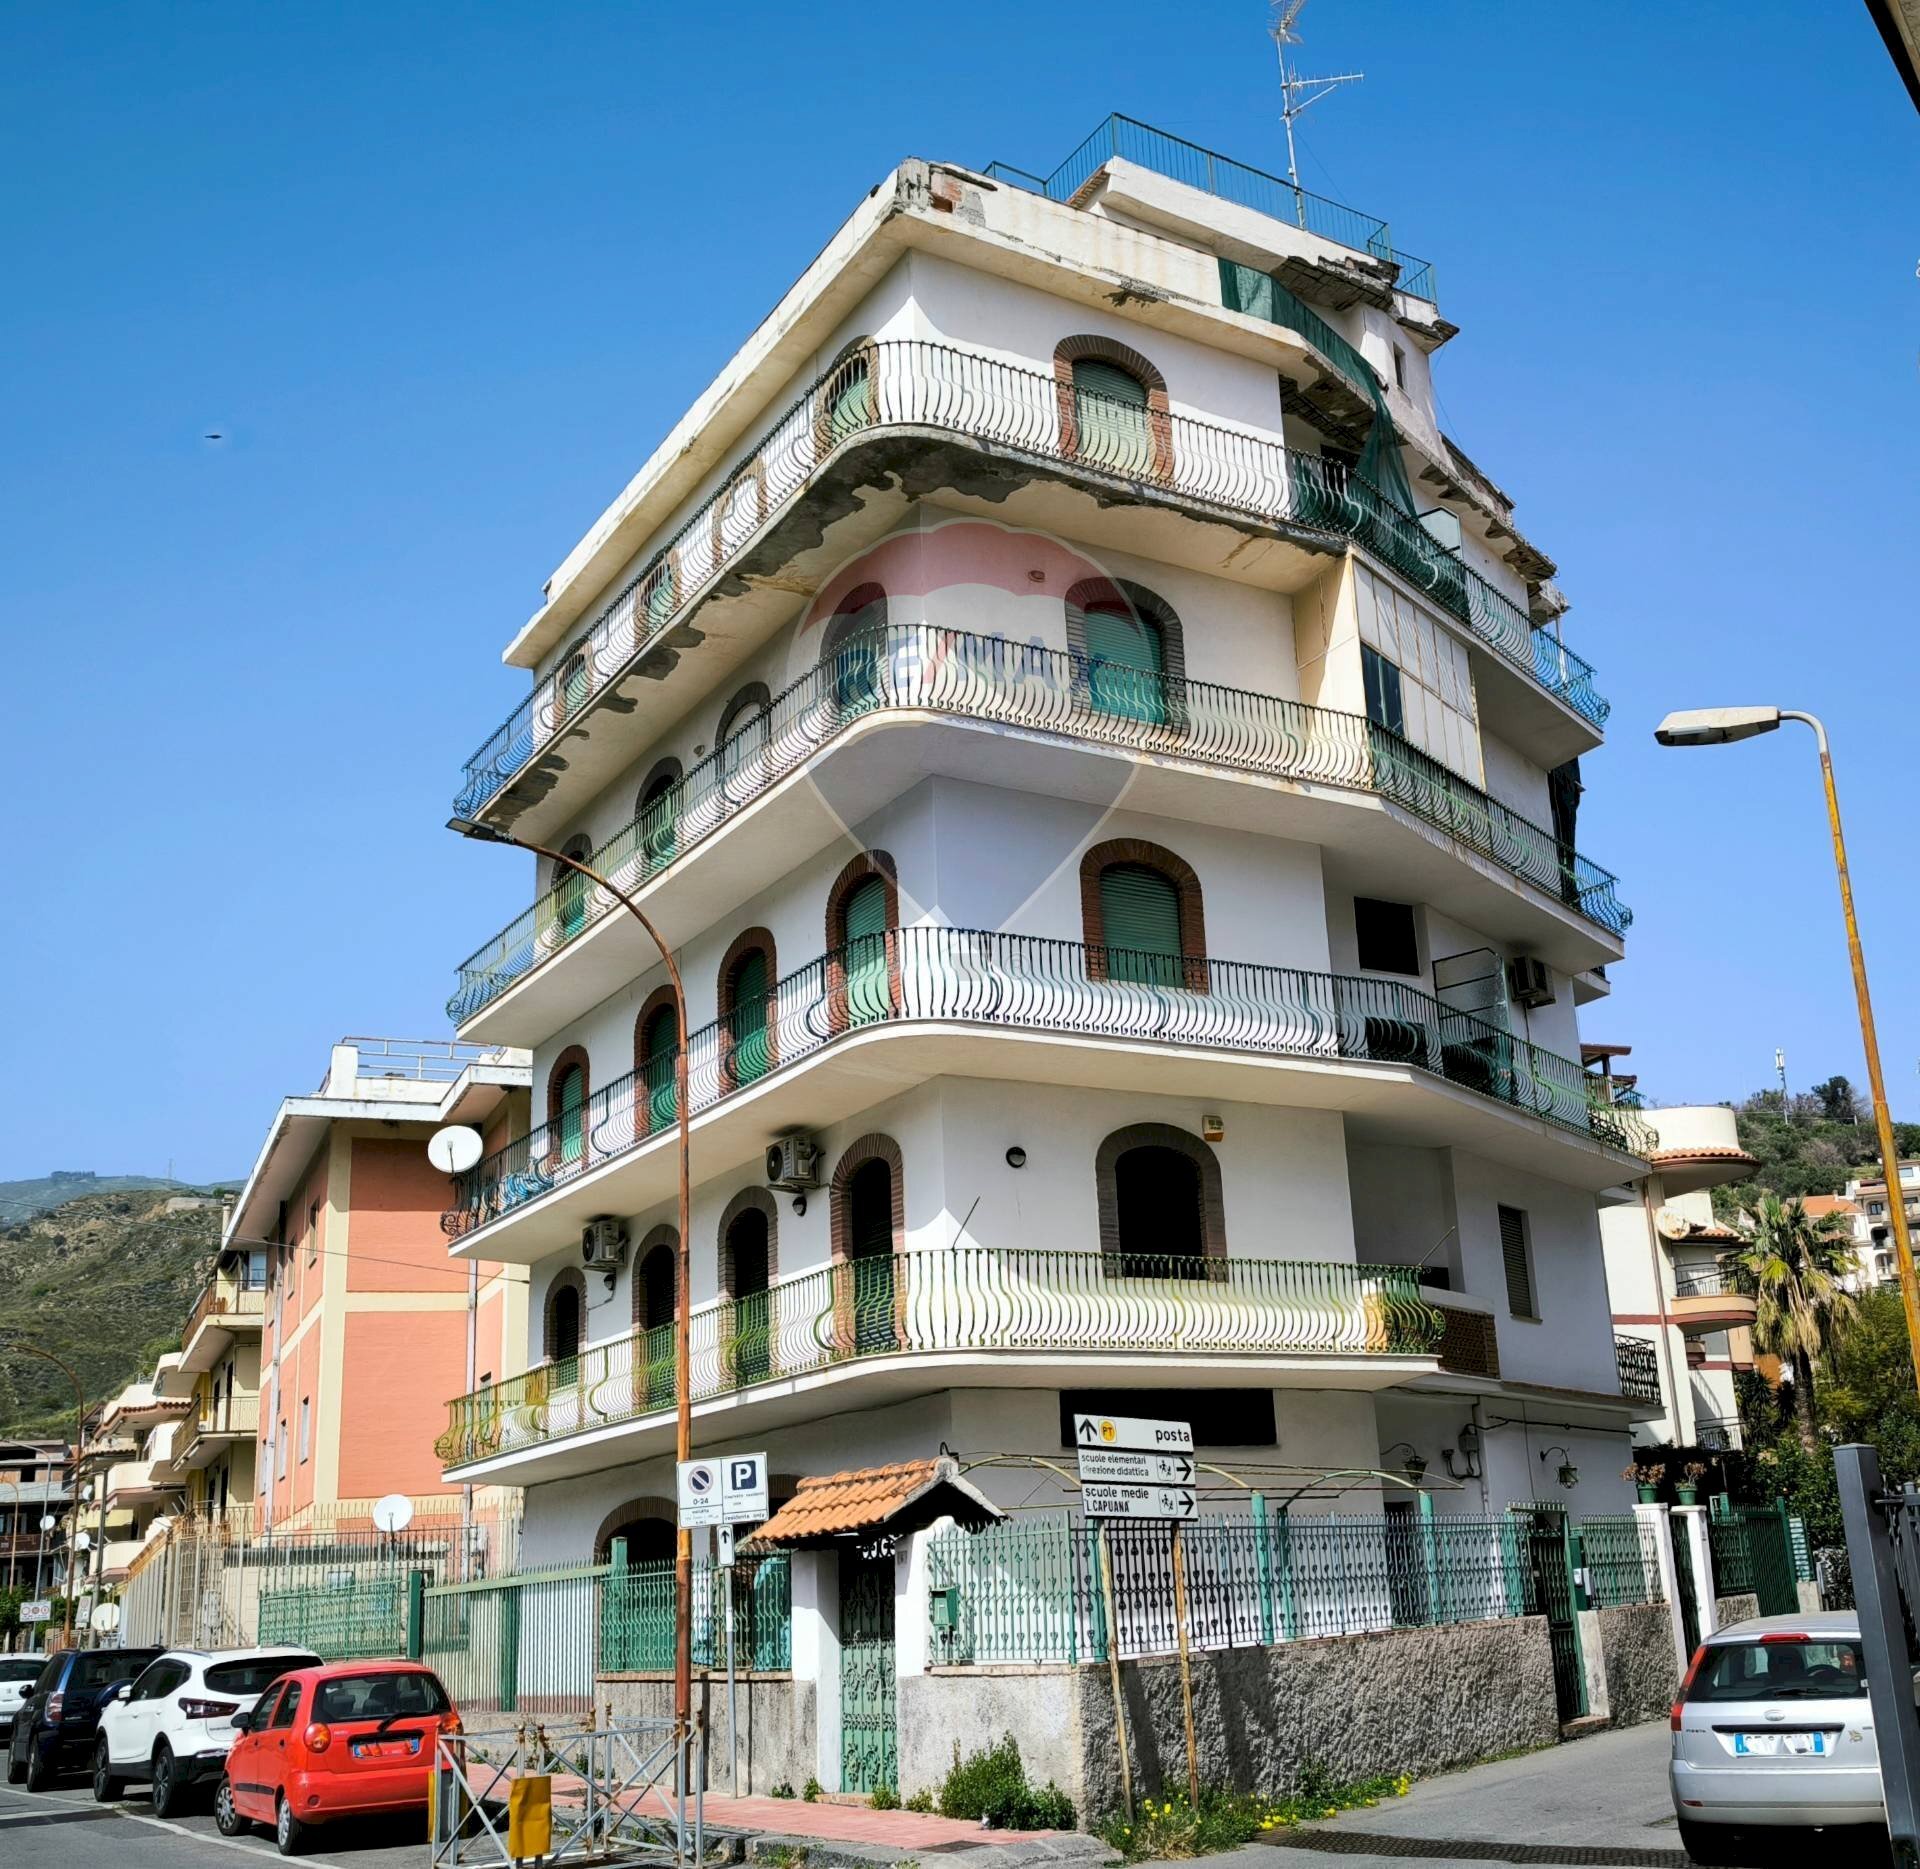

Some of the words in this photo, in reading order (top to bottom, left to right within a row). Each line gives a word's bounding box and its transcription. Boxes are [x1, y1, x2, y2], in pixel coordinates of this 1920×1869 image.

[1155, 1429, 1190, 1443] posta
[1081, 1455, 1106, 1463] scuole
[1107, 1456, 1147, 1465] elementari
[735, 1464, 752, 1488] P
[1082, 1465, 1116, 1475] direzione
[1116, 1466, 1149, 1477] didattica
[1085, 1487, 1118, 1498] scuole
[1121, 1488, 1150, 1499] medie
